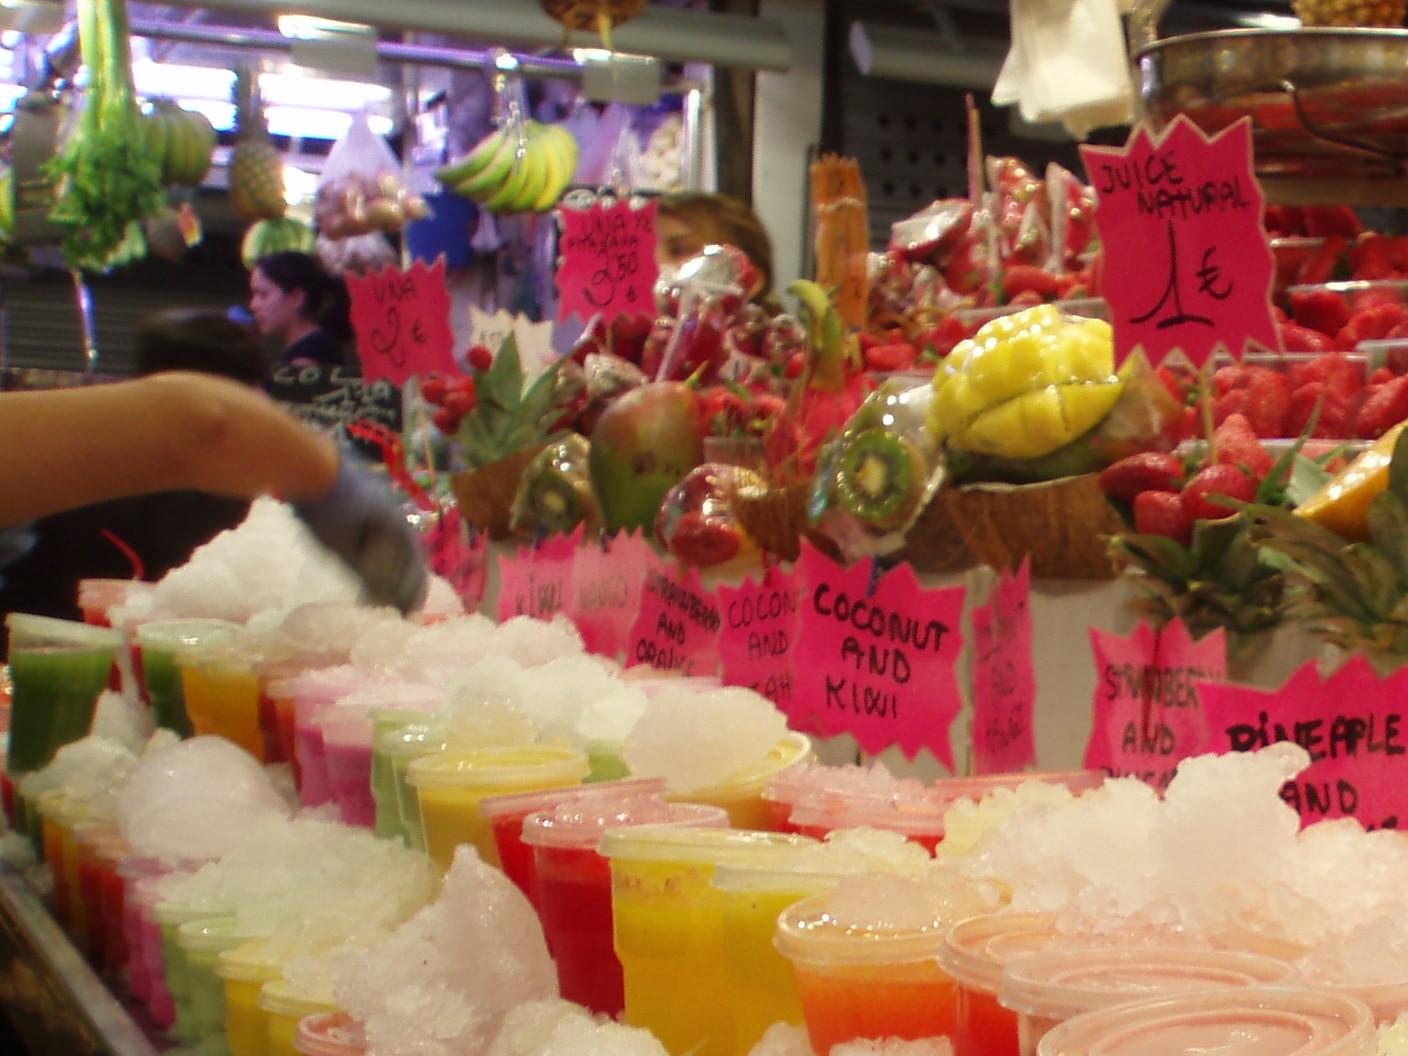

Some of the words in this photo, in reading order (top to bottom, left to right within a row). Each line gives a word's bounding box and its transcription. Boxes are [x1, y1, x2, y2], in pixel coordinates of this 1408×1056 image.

[1101, 149, 1184, 194] JUICE
[1137, 175, 1249, 221] NATURAL
[374, 276, 417, 301] UNA
[656, 611, 686, 646] AND
[728, 590, 796, 629] COCON
[813, 582, 950, 652] COCONUT
[748, 630, 789, 660] AND
[841, 635, 911, 684] AND
[825, 675, 898, 719] KIWI
[1277, 777, 1358, 815] AND
